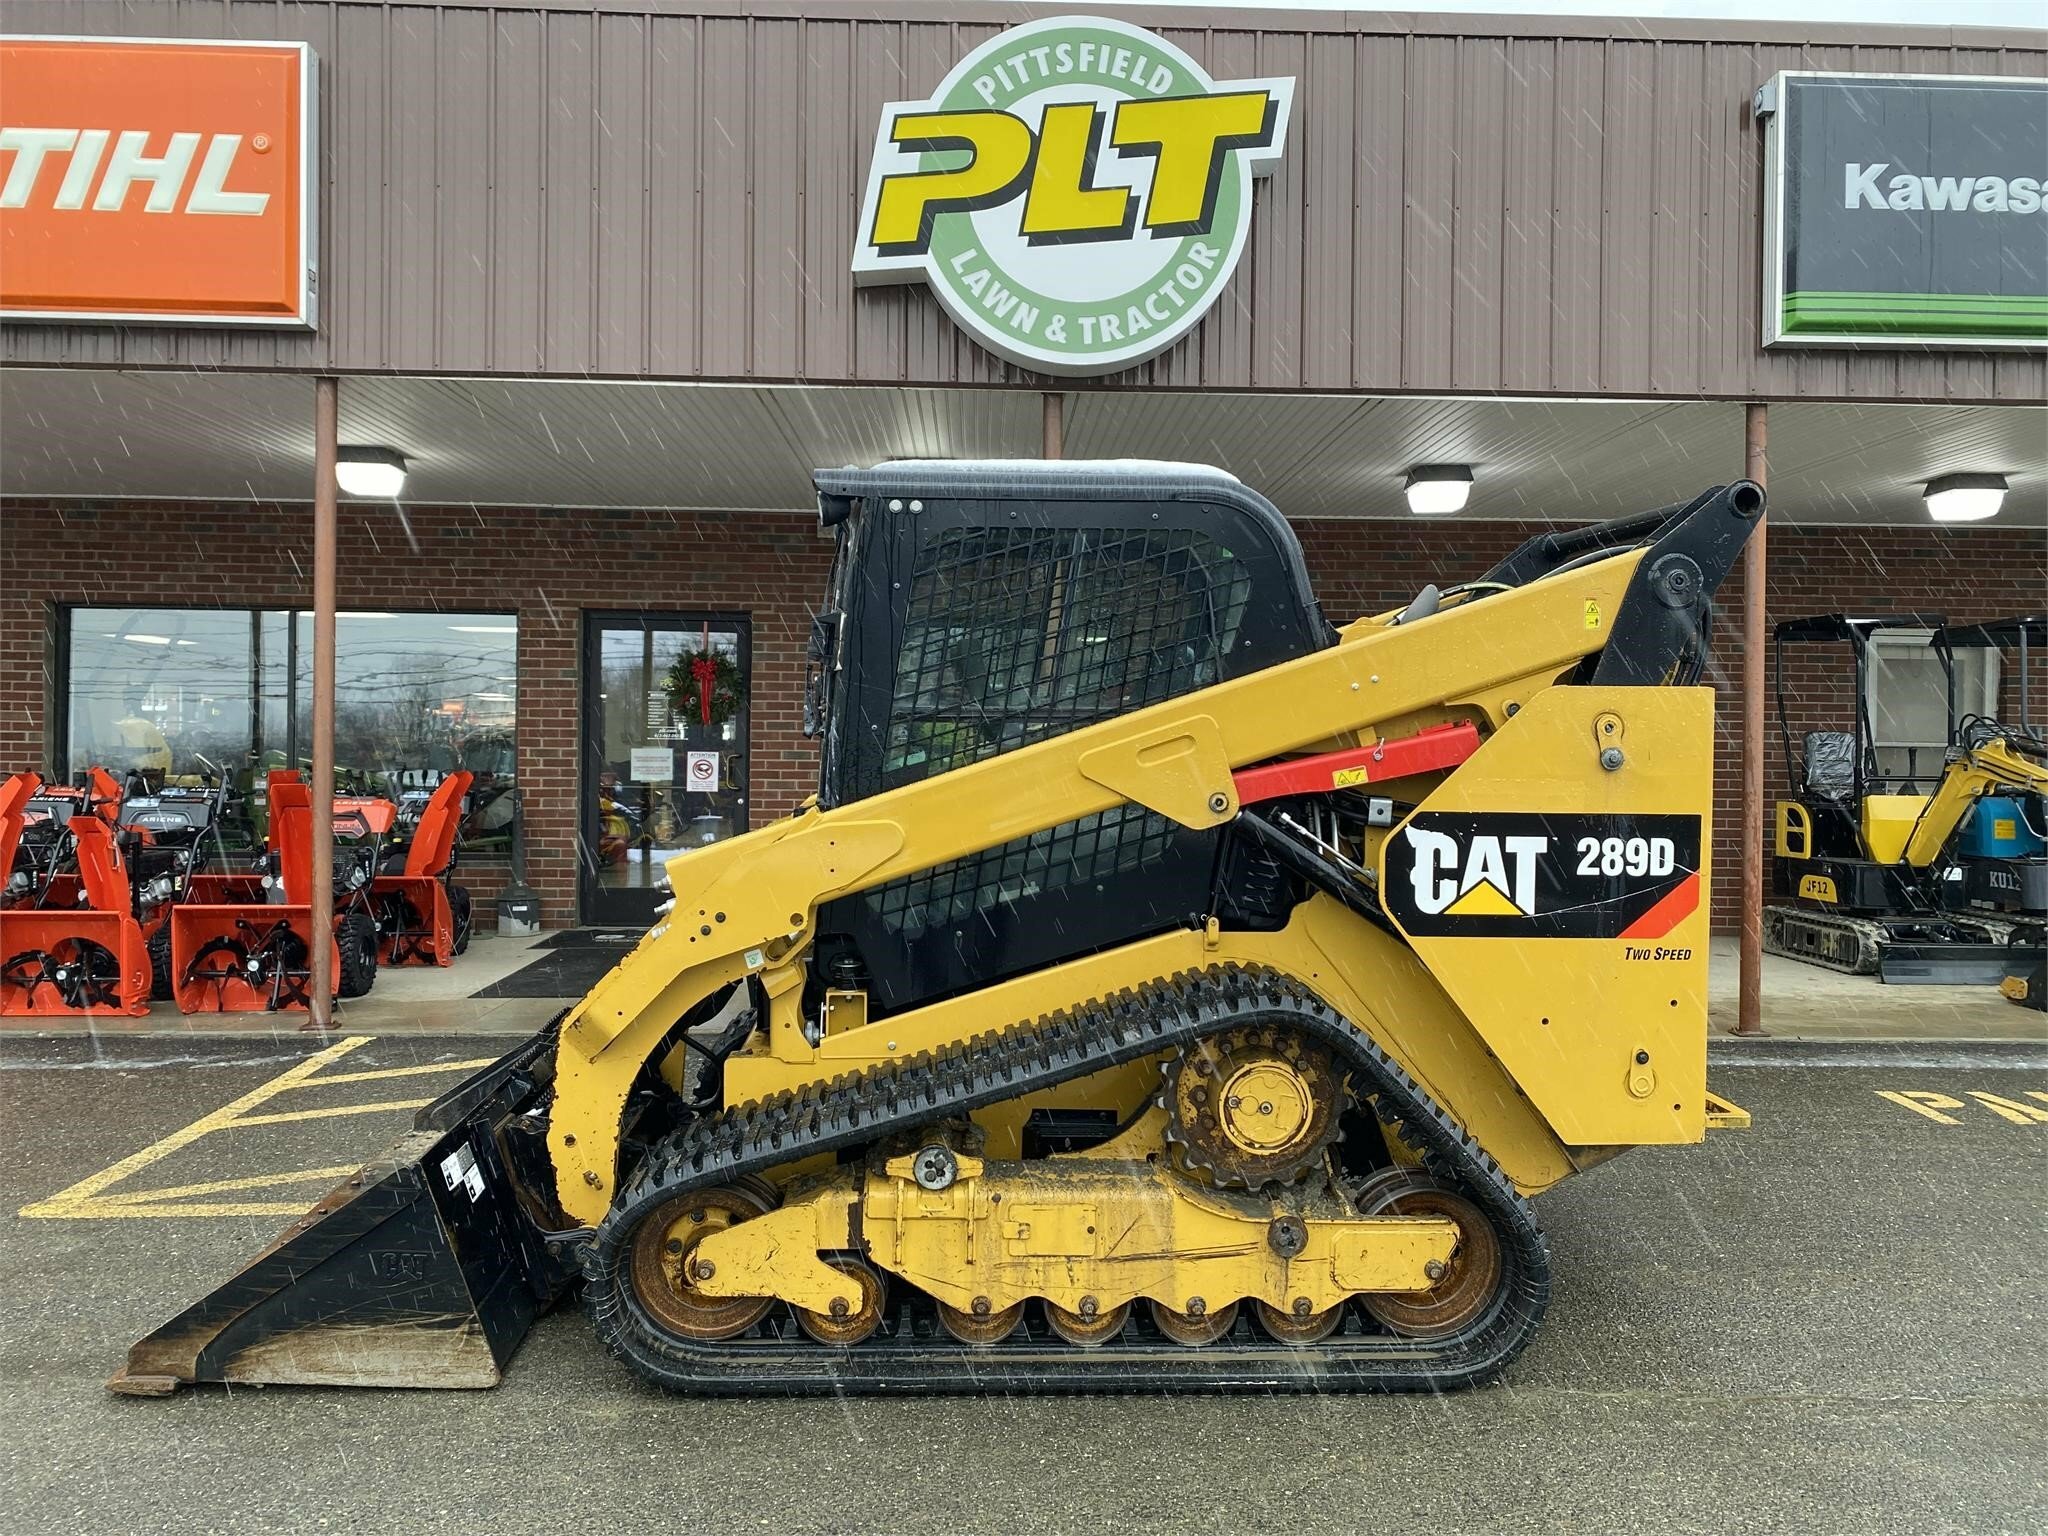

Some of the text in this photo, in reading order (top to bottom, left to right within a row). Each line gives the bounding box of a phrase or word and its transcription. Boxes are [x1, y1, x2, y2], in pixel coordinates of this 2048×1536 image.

[973, 41, 1174, 106] PITTSFIELD
[869, 90, 1277, 254] PLT
[1844, 162, 2048, 215] Kawas
[949, 241, 1221, 345] LAWN & TRACTOR
[1404, 825, 1675, 916] CAT 289D
[1806, 880, 1828, 895] JF12
